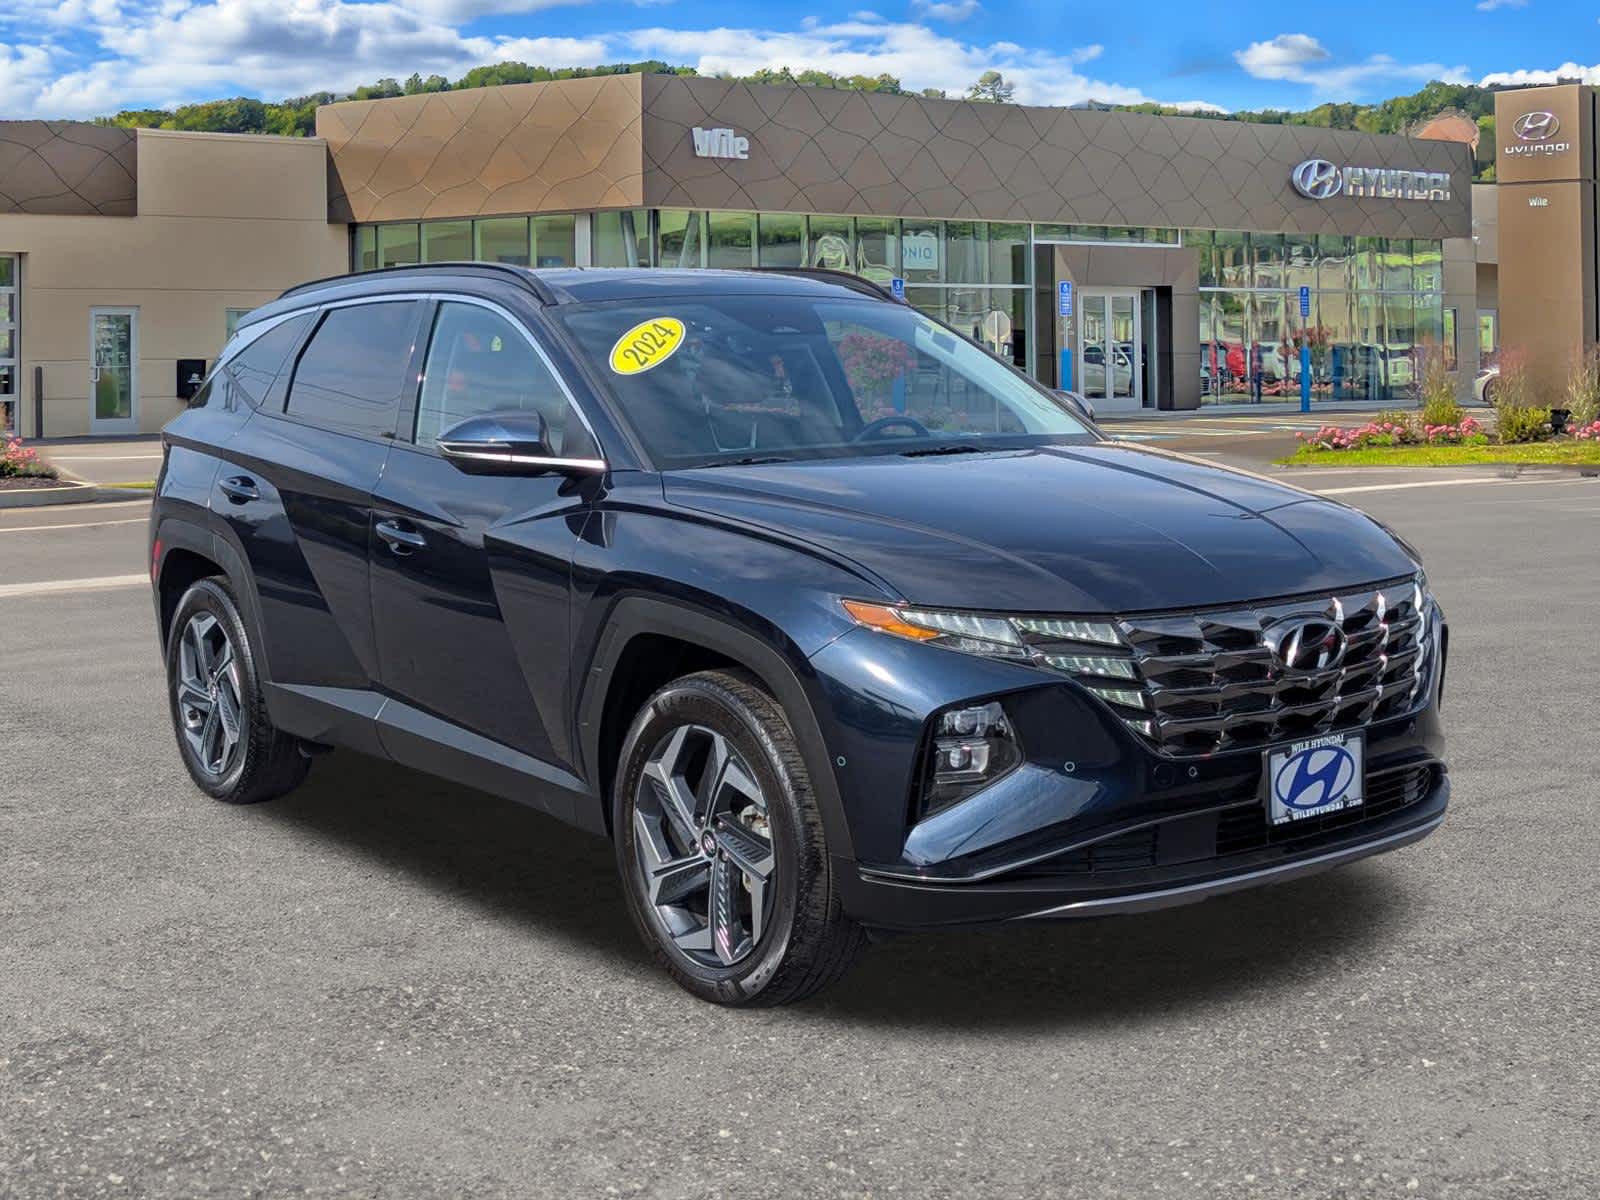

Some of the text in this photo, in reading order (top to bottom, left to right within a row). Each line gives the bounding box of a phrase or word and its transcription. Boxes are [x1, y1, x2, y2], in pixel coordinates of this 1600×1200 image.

[692, 127, 749, 159] Wile
[1342, 166, 1450, 200] HYUNDAI
[623, 323, 676, 366] 2024
[1291, 733, 1344, 753] WILE HYUNDAI
